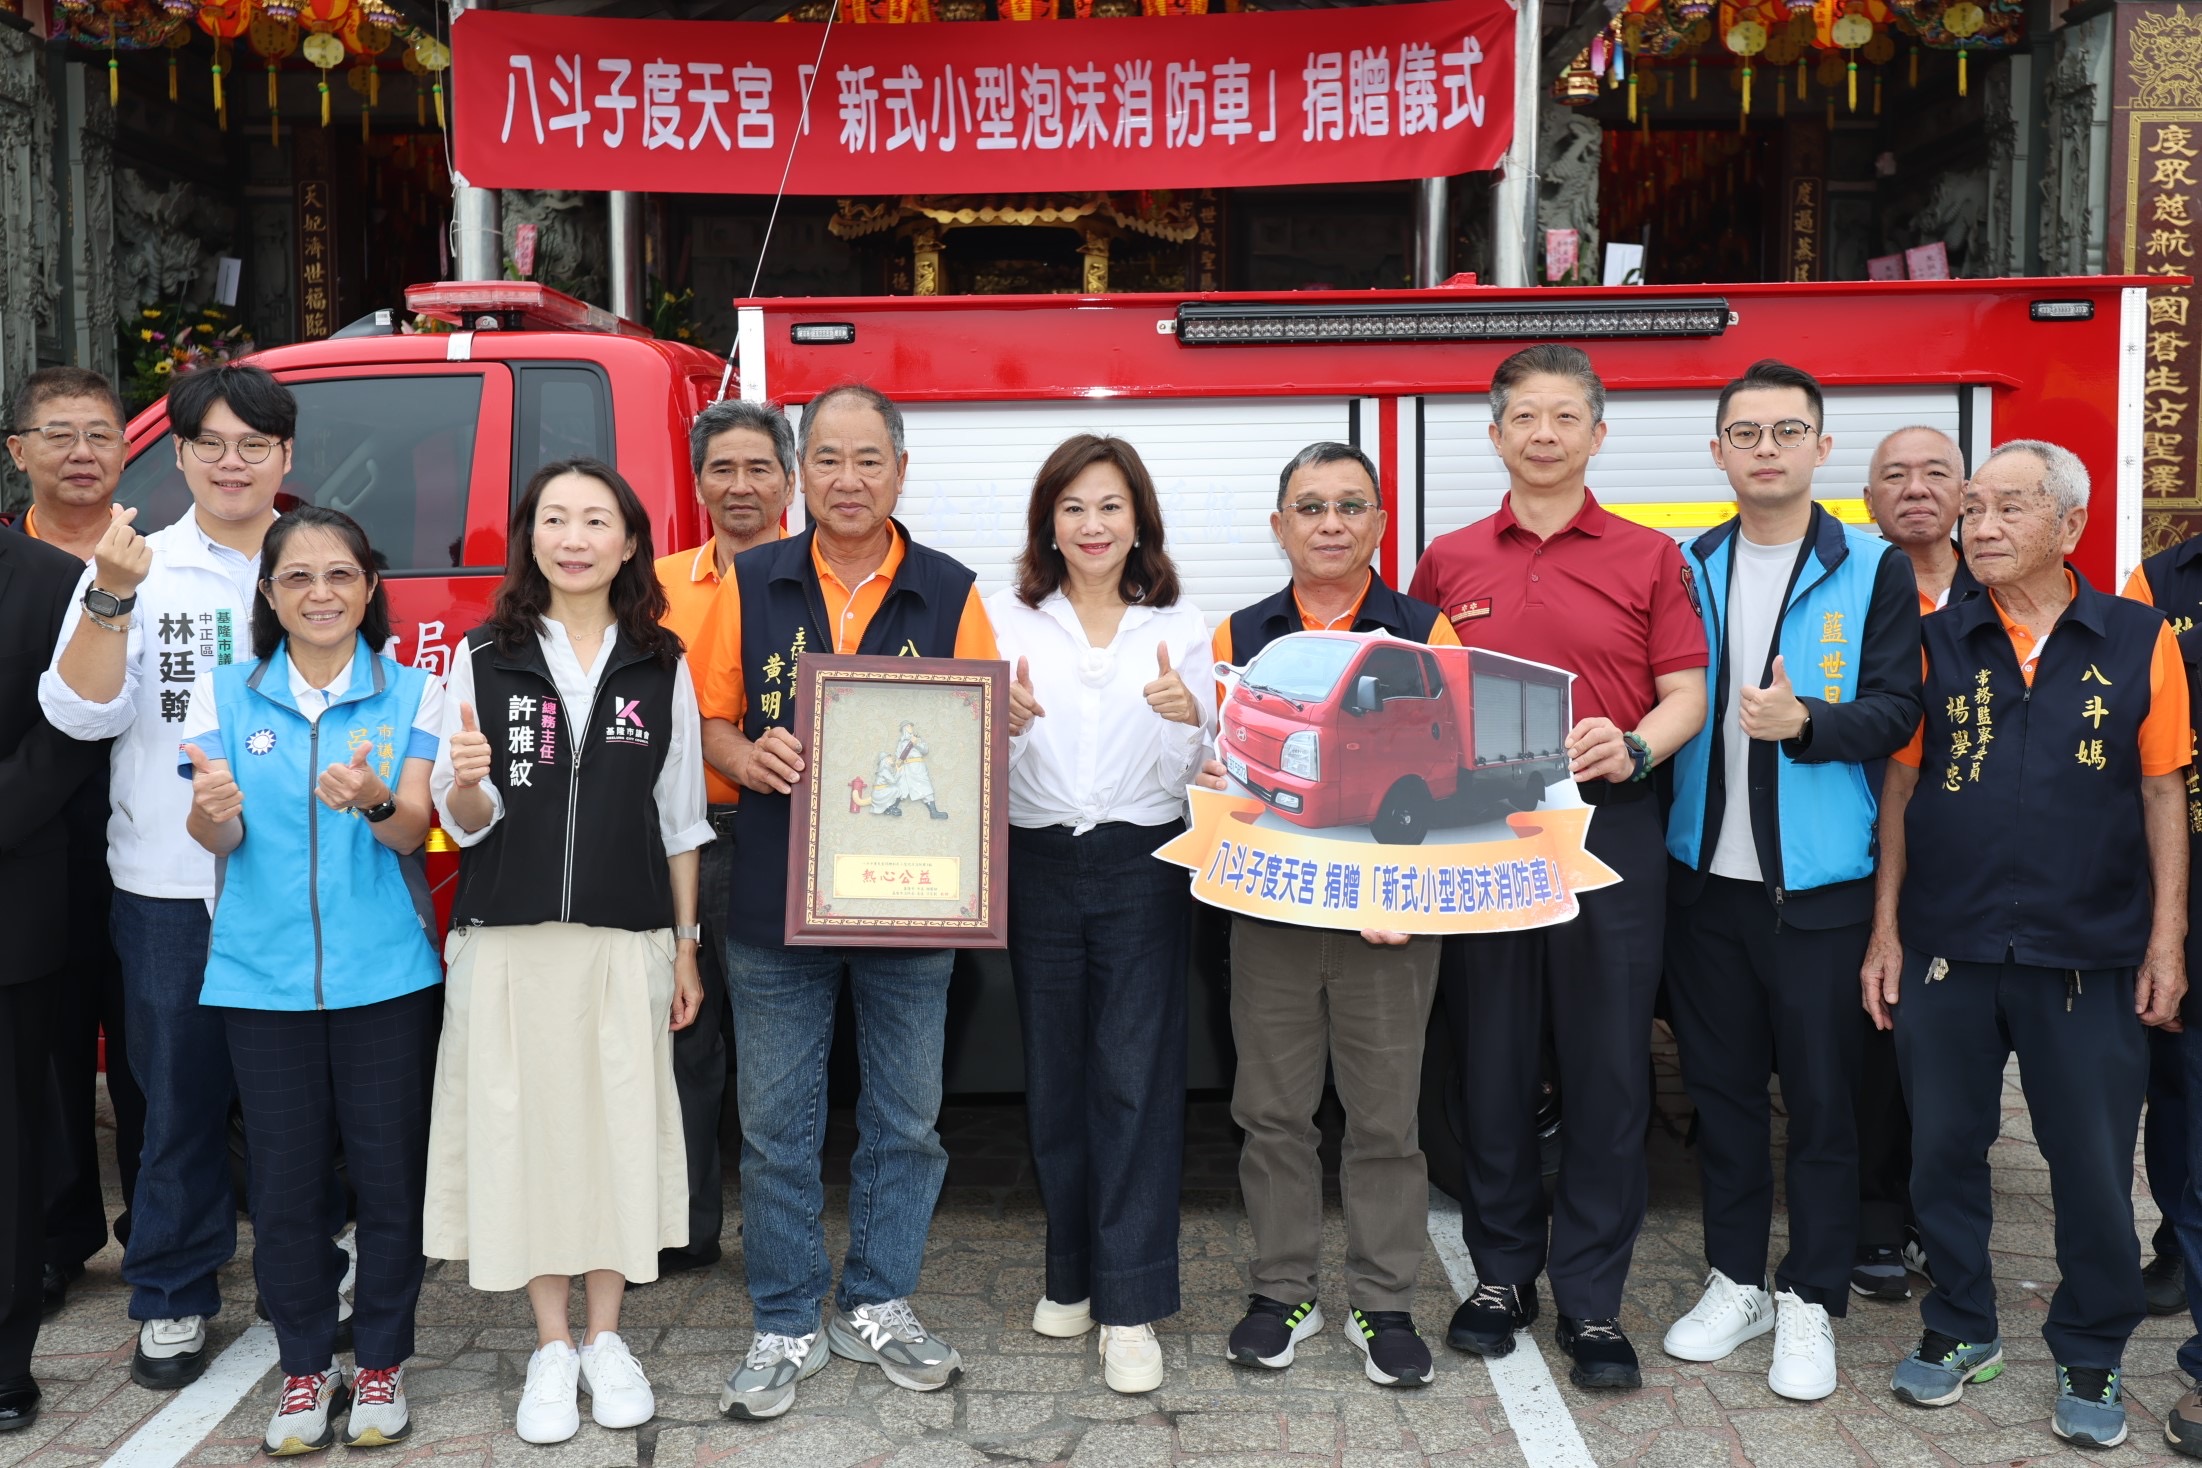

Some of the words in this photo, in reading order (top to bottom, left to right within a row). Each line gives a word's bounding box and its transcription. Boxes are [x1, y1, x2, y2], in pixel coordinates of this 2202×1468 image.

[199, 612, 214, 656] 中正區
[761, 653, 786, 733] 黃明
[1968, 669, 1994, 782] 常務監察委員
[2075, 663, 2112, 771] 八斗媽
[376, 724, 395, 778] 市議員
[508, 694, 537, 787] 許雅紋
[539, 701, 557, 759] 總務主任
[606, 726, 650, 740] 基隆市議會
[1942, 695, 1972, 792] 楊學忠
[862, 869, 932, 885] 熱心公益
[1207, 842, 1318, 905] 八斗子度天宮
[1323, 861, 1361, 910] 捐贈
[1371, 855, 1563, 914] 「新式小型泡沫消防車」
